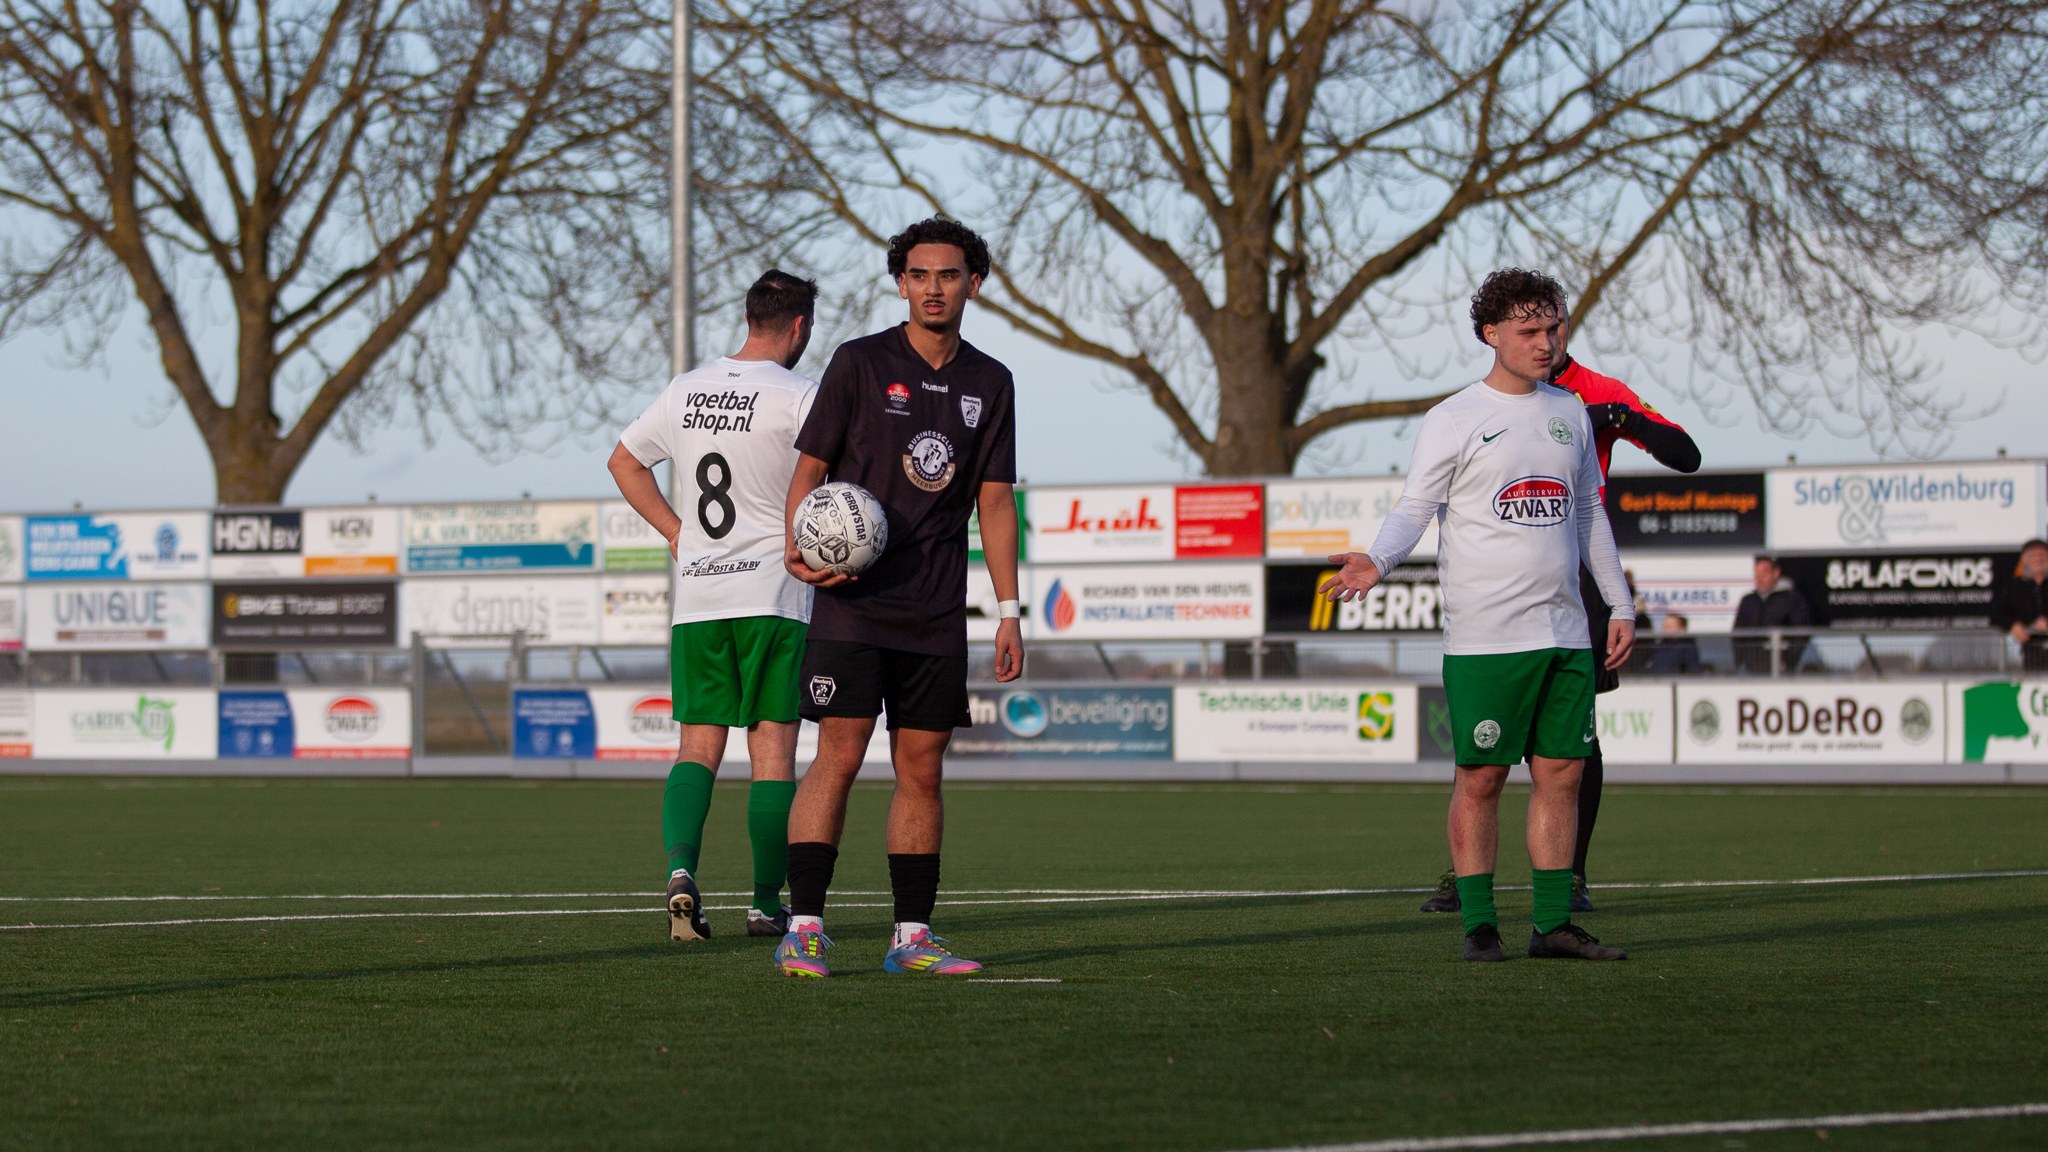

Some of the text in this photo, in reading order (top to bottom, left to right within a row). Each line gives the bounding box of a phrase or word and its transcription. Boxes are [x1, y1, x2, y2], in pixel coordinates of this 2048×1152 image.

[686, 390, 759, 411] voetbal
[888, 389, 909, 397] SPORT
[922, 380, 949, 393] hummel
[682, 408, 754, 435] shop.nl
[907, 430, 954, 458] BUSINESSCLUB
[695, 451, 736, 540] 8
[1506, 488, 1567, 498] AUTOSERVICE
[1795, 478, 1842, 505] Slof
[1868, 474, 2015, 508] Wildenburg
[842, 491, 866, 541] DERBYSTAR
[1271, 490, 1361, 525] polytex
[1498, 498, 1569, 520] ZWART
[214, 515, 272, 551] HGN
[329, 517, 374, 538] HGN
[1826, 557, 1993, 589] &PLAFONDS
[1084, 583, 1252, 598] RICHARD VAN DEN HEUVEL
[54, 590, 168, 626] UNIQUE
[452, 586, 549, 626] dennis
[1084, 603, 1253, 621] INSTALLATIETECHNIEK
[1051, 693, 1169, 731] beveiliging
[1198, 691, 1350, 712] Technische Unie
[1736, 698, 1884, 736] RoDeRo
